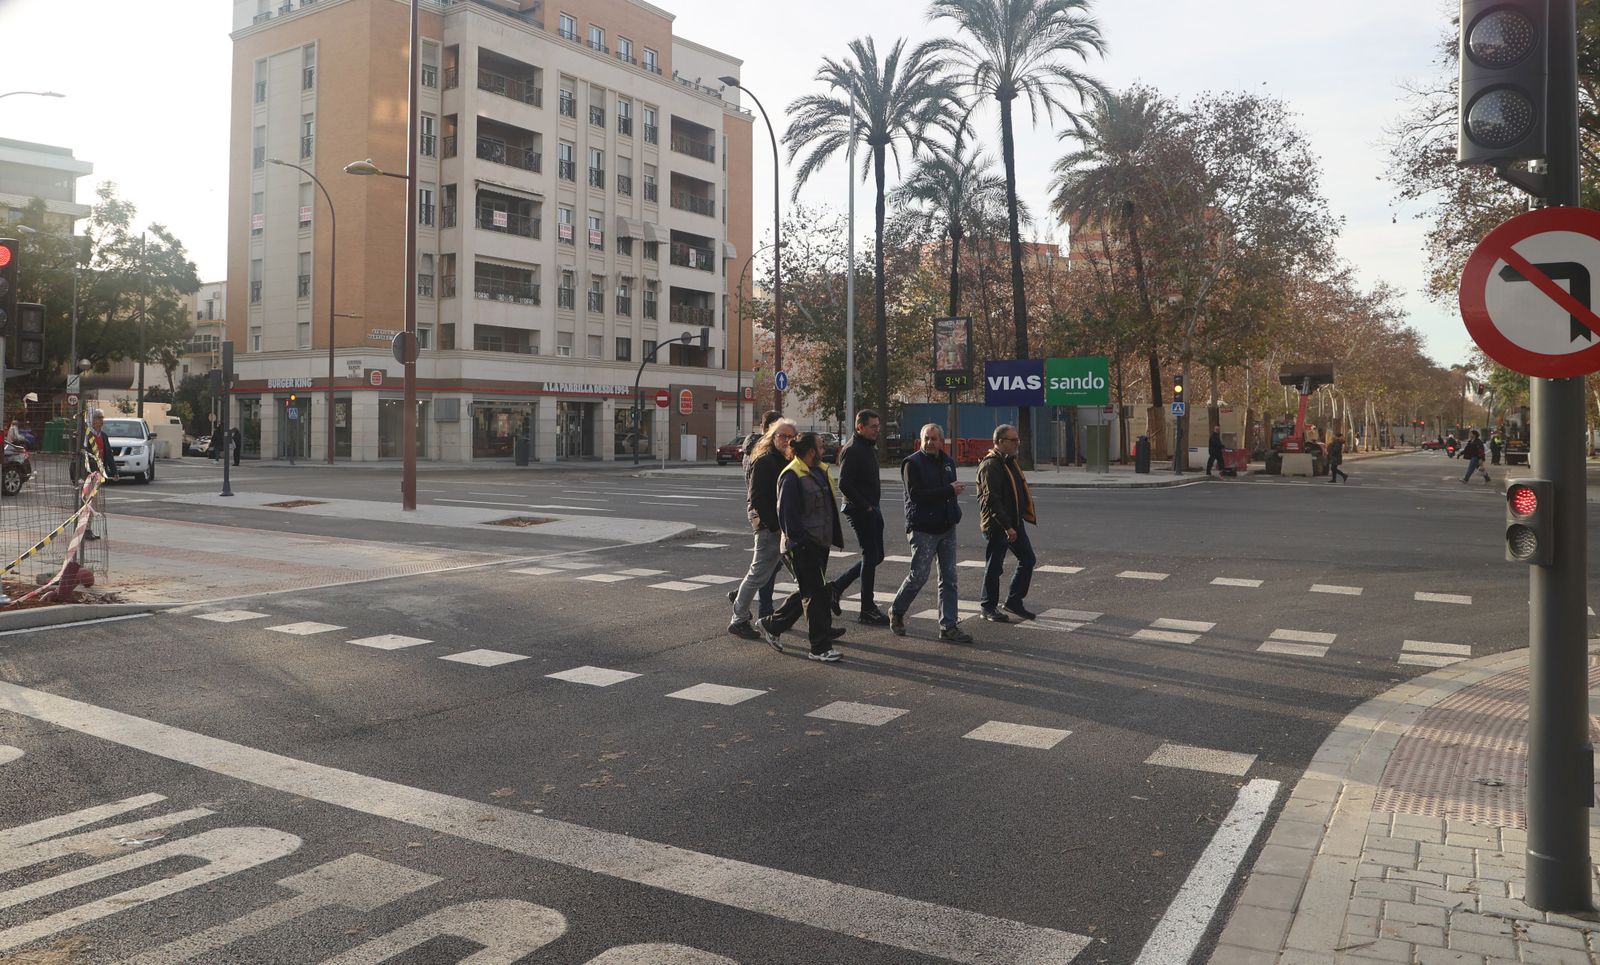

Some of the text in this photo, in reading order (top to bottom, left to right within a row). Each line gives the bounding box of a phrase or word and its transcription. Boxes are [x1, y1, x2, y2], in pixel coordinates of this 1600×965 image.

[268, 377, 312, 388] BURGER KING
[988, 375, 1042, 391] VIAS
[1049, 371, 1105, 390] sando
[560, 383, 593, 393] PARRILLA
